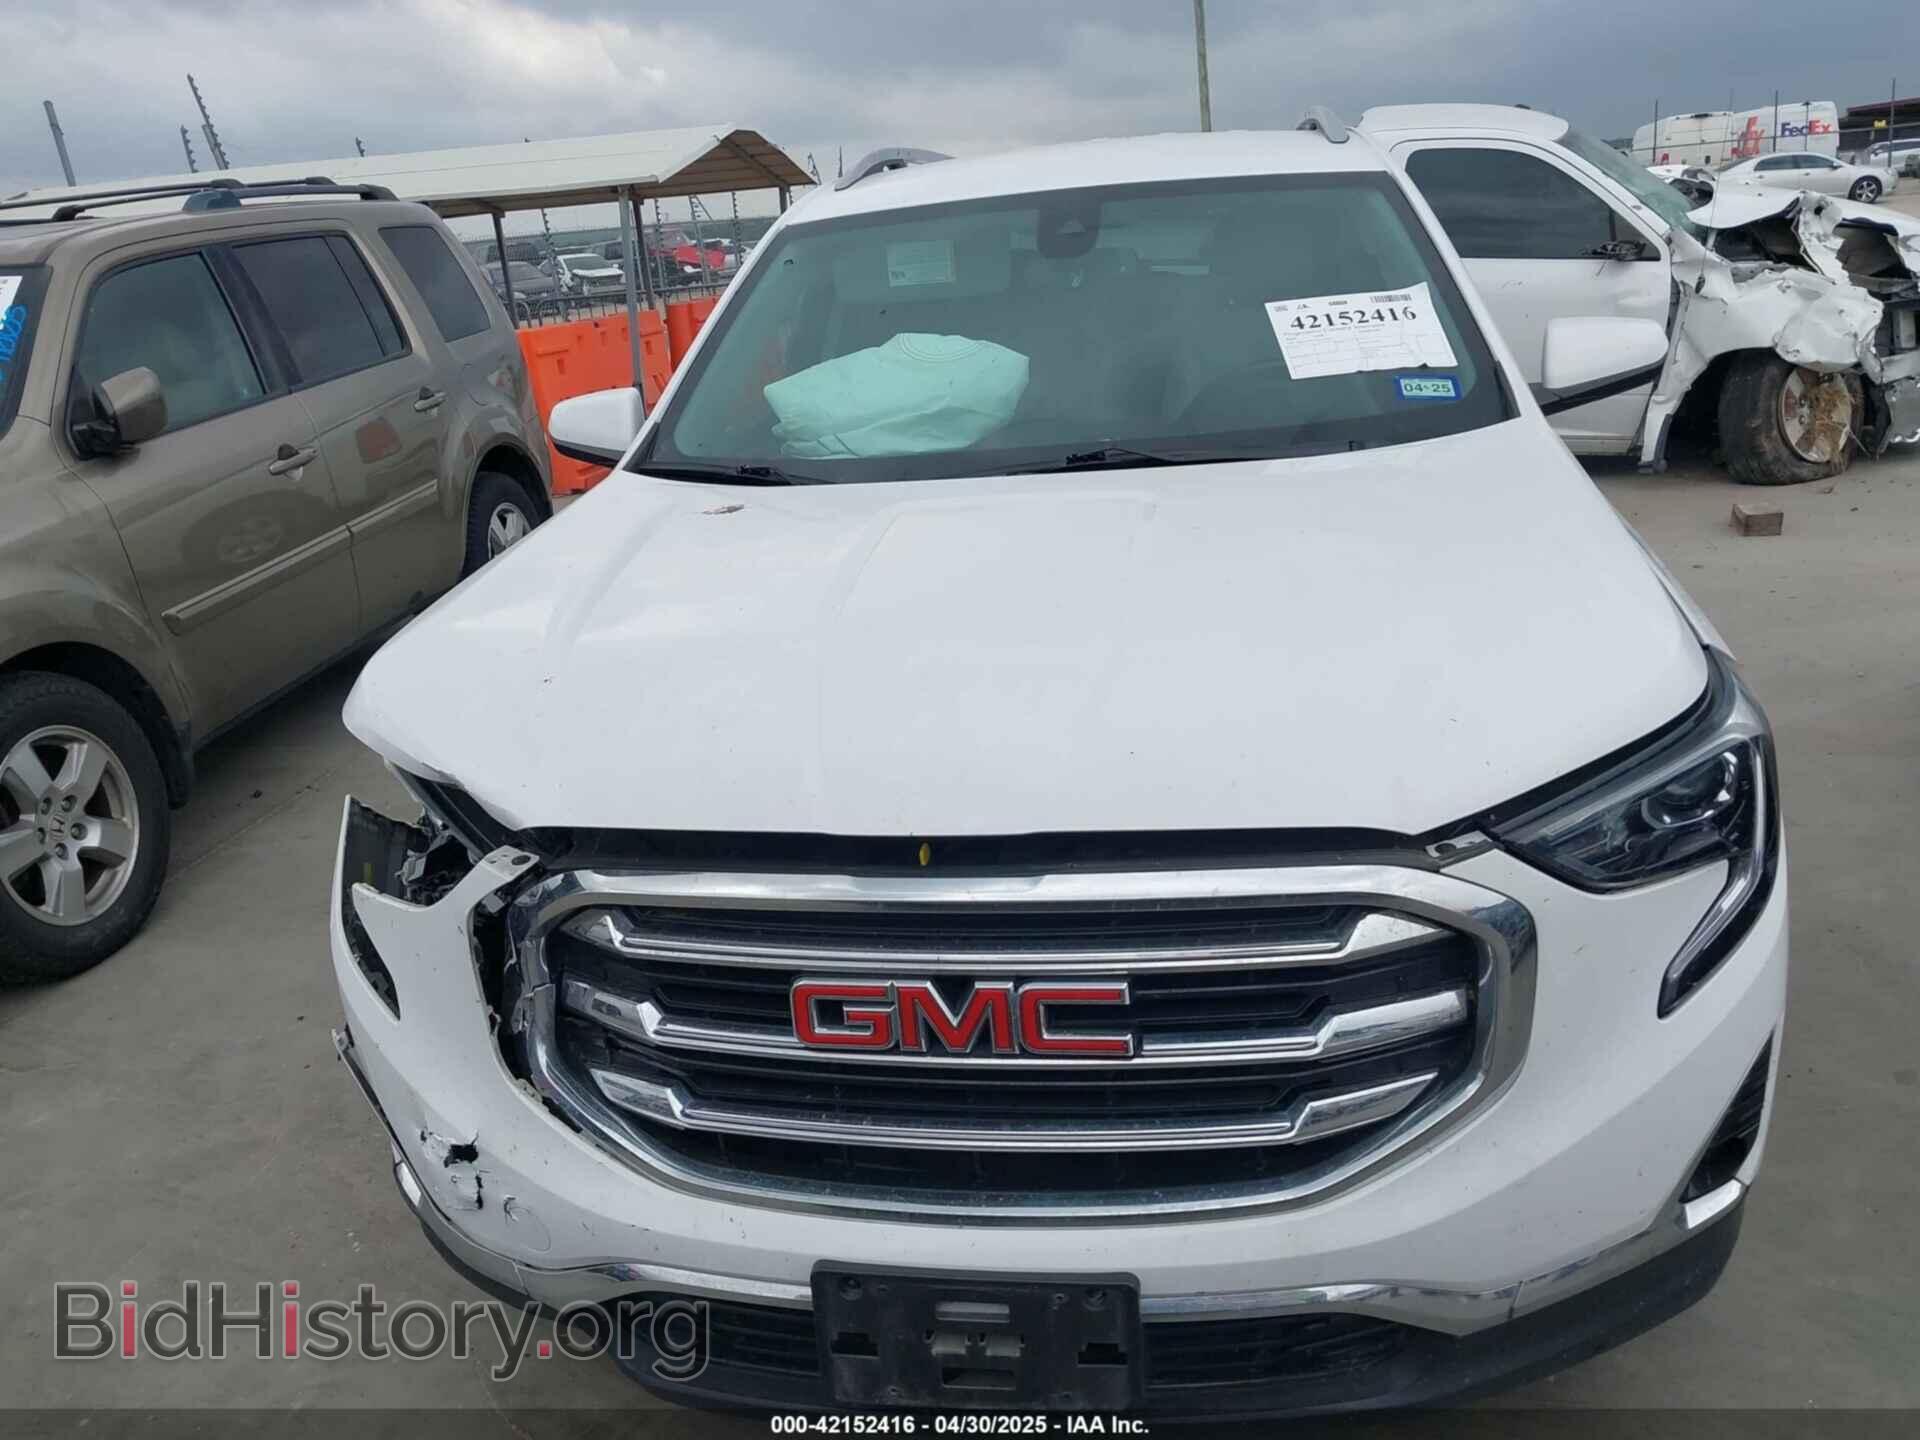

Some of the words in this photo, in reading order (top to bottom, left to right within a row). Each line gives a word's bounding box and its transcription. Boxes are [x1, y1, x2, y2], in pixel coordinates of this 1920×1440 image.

[1780, 119, 1832, 138] FedEx
[1290, 306, 1417, 330] 42152416
[790, 979, 1134, 1057] GMC
